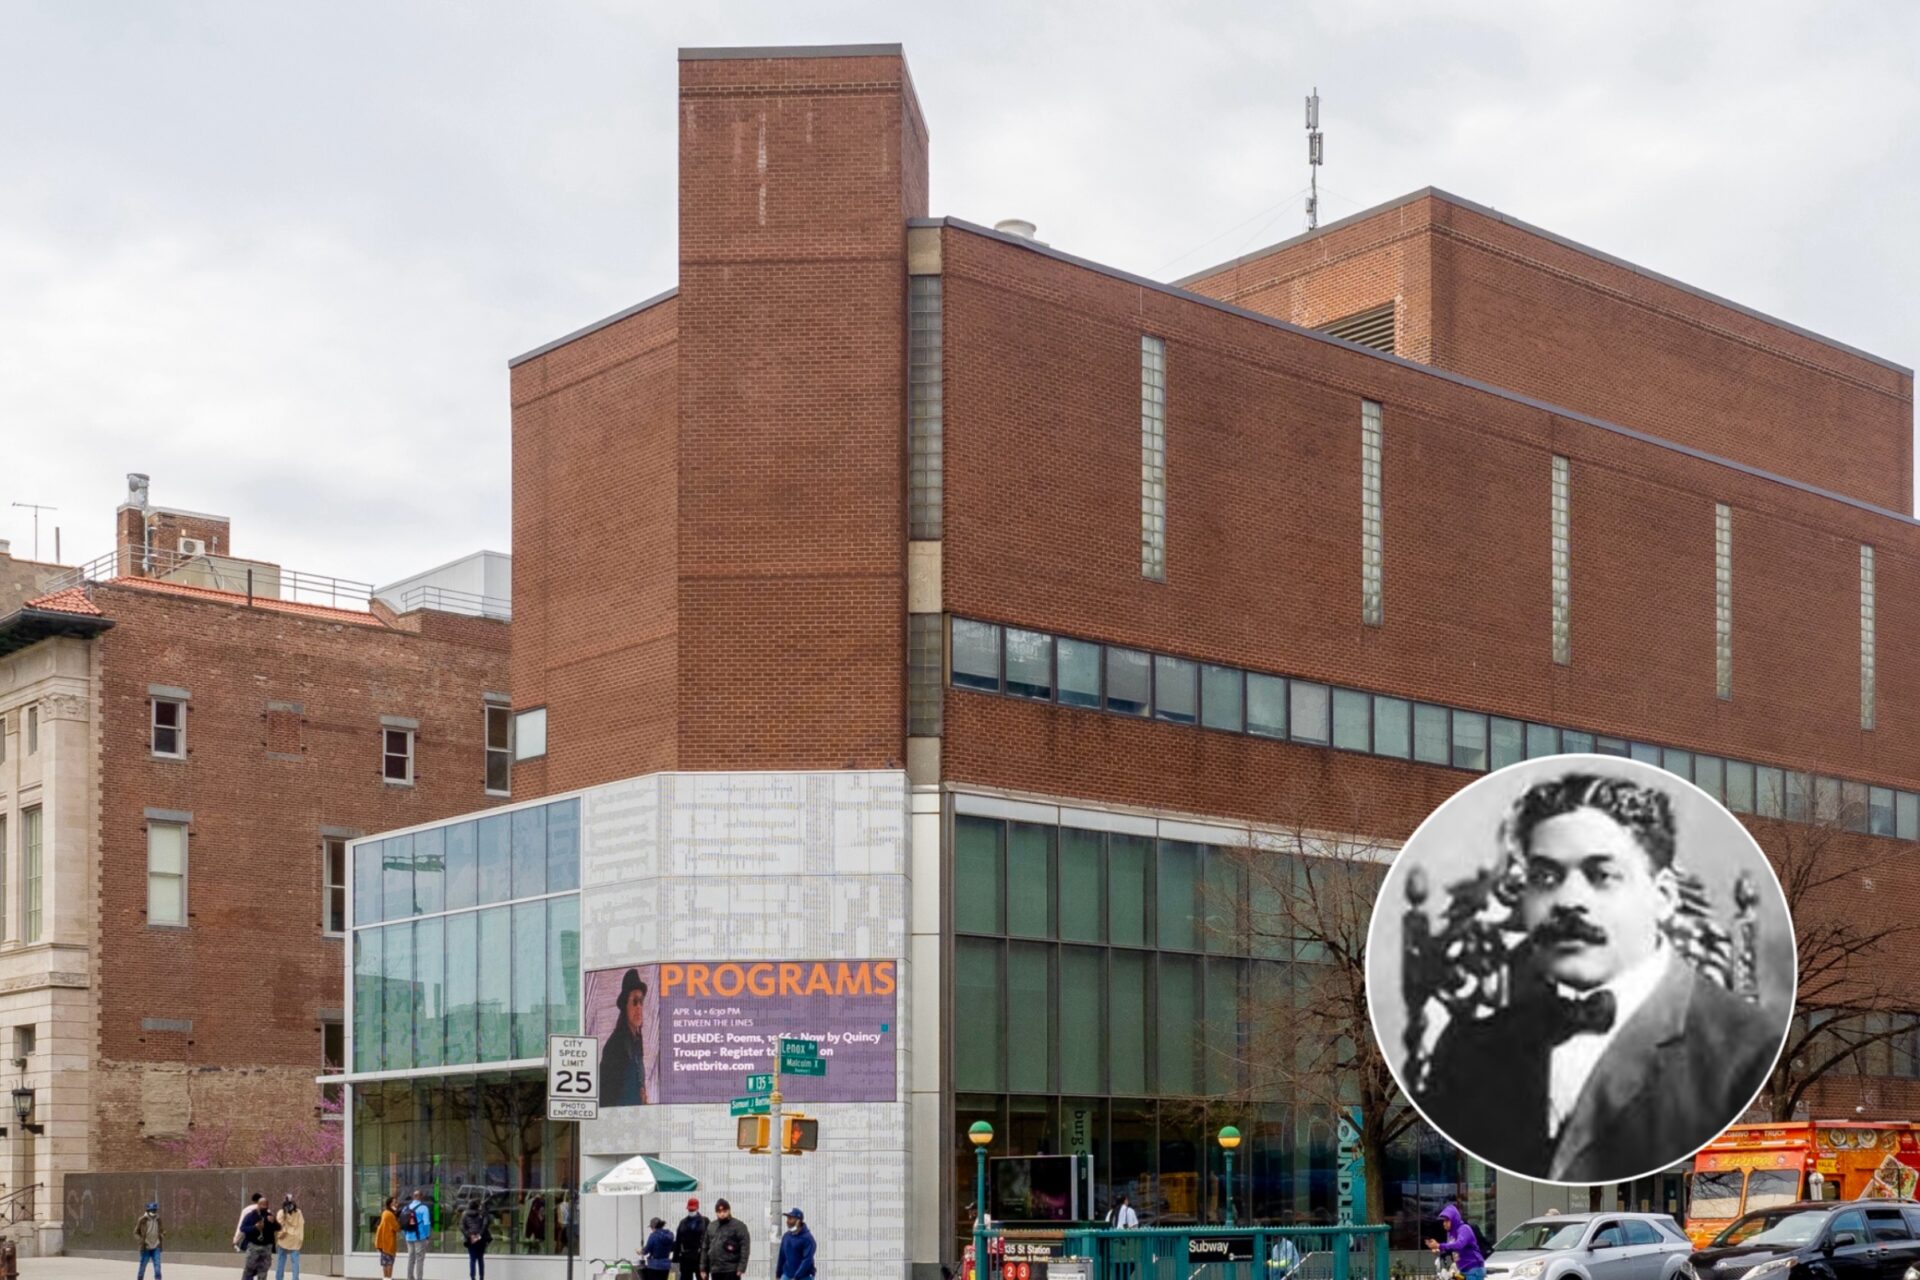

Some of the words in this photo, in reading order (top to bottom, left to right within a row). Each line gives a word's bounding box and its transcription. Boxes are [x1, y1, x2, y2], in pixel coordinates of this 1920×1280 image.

[660, 963, 896, 997] PROGRAMS
[673, 1008, 689, 1016] APR
[727, 1007, 741, 1015] PM
[673, 1019, 711, 1027] BETWEEN
[713, 1019, 729, 1027] THE
[731, 1019, 753, 1027] LINES
[673, 1033, 724, 1043] DUENDE:
[726, 1033, 764, 1043] Poems,
[800, 1033, 825, 1042] Now
[827, 1032, 840, 1044] by
[843, 1032, 881, 1044] Quincy
[673, 1048, 711, 1059] Troupe
[720, 1047, 763, 1059] Register
[819, 1048, 833, 1056] on
[782, 1041, 805, 1054] Lenox
[673, 1061, 754, 1071] Eventbrite.com
[787, 1058, 812, 1068] Malcolm
[556, 1070, 592, 1093] 25
[756, 1076, 767, 1090] 135
[1018, 1245, 1025, 1254] St
[1027, 1244, 1051, 1254] Station
[1189, 1240, 1229, 1255] Subway
[1007, 1266, 1013, 1277] 2
[1020, 1266, 1026, 1277] 3
